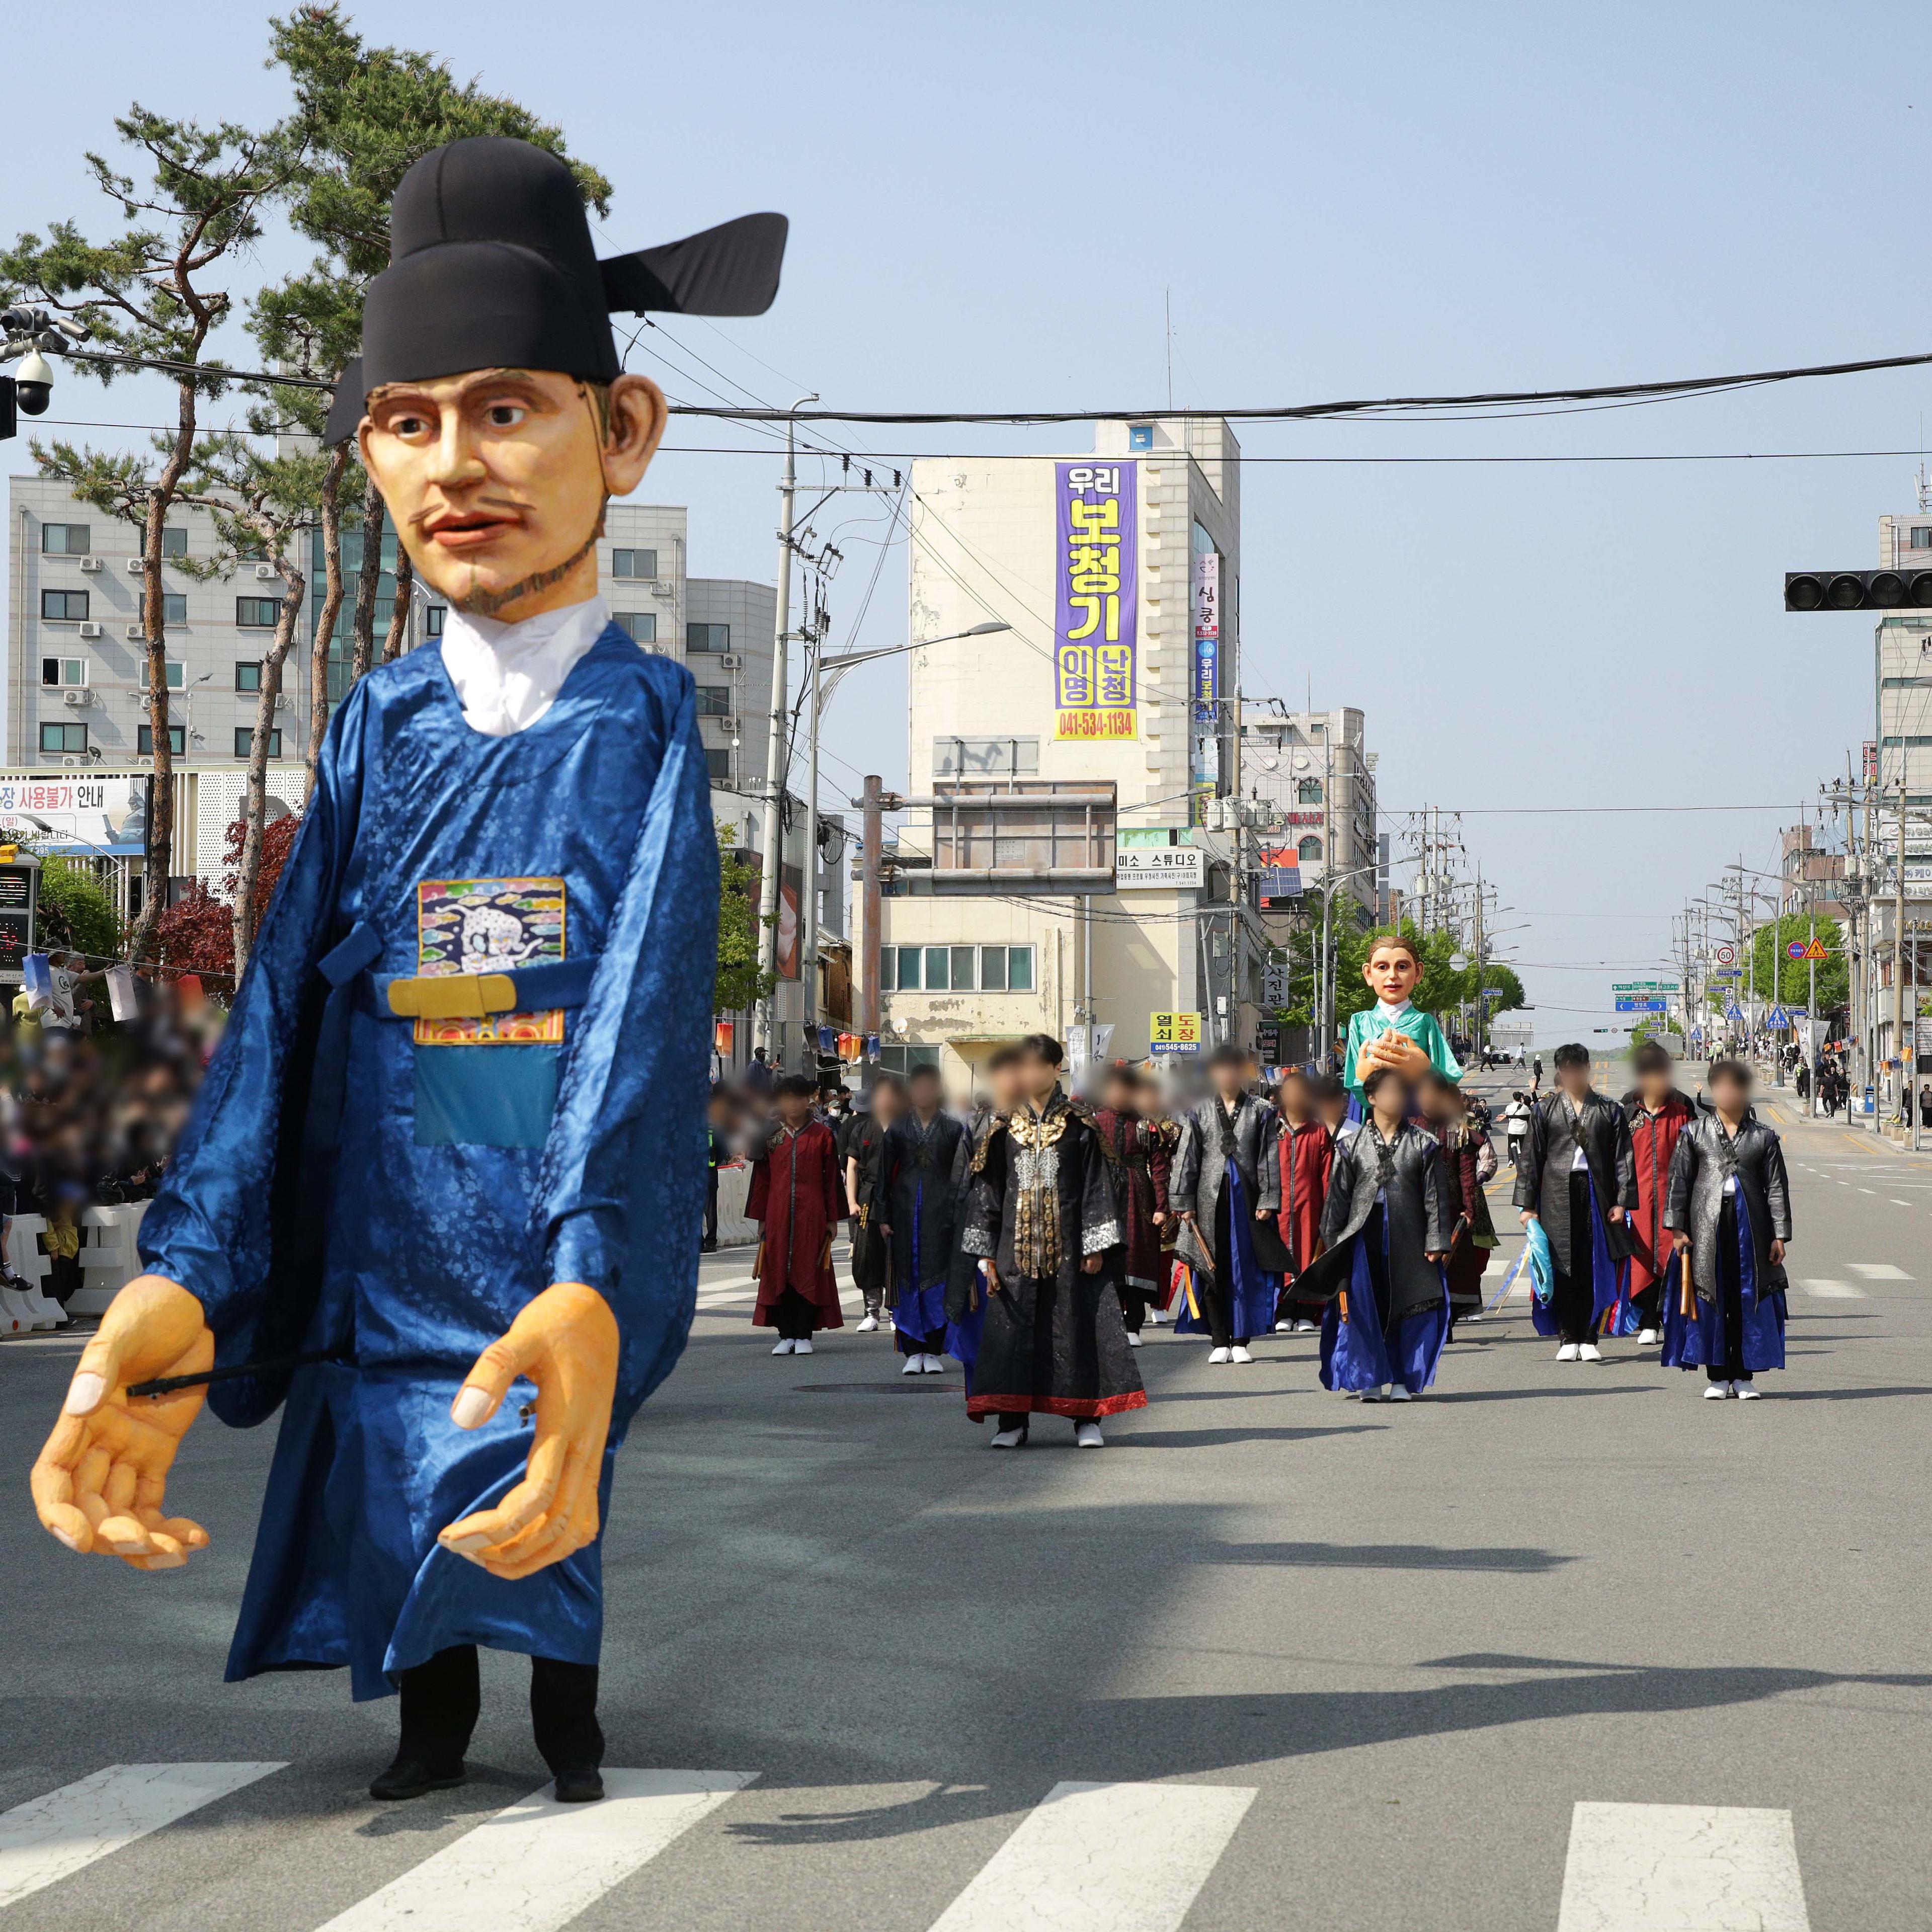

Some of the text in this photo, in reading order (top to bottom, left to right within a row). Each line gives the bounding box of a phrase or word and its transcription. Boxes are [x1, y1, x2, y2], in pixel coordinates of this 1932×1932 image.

[1068, 467, 1119, 495] 우리
[1067, 498, 1122, 641] 보청기
[1201, 658, 1213, 679] 우리
[1059, 711, 1132, 736] 041-534-1134
[19, 786, 72, 809] 사용불가
[77, 786, 103, 808] 안내
[1119, 854, 1196, 866] 미소 스튜디오
[1268, 968, 1284, 1005] 사진관
[1156, 1015, 1172, 1040] 열쇠
[1178, 1015, 1195, 1040] 도장
